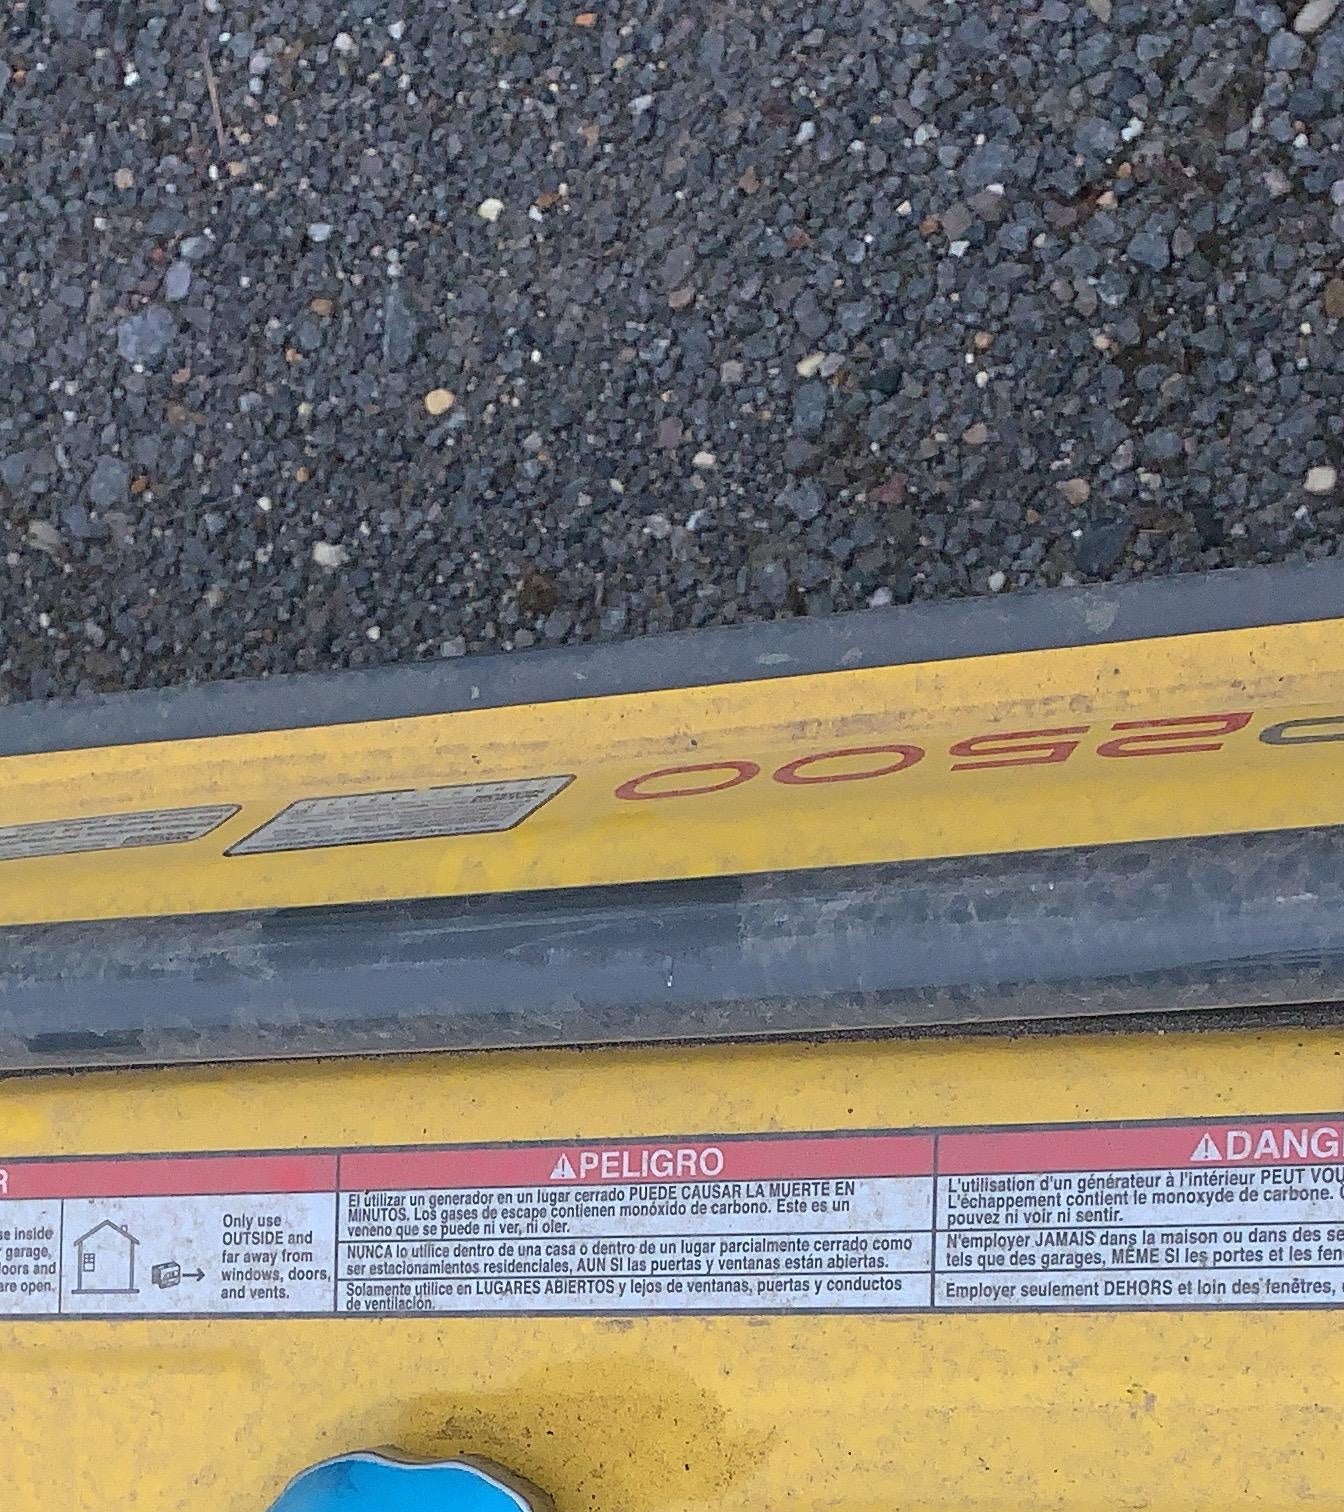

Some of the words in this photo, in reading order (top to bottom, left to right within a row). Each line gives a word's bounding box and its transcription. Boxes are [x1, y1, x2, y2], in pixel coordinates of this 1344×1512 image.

[579, 1147, 724, 1179] PELIGRO
[223, 1214, 253, 1231] Only
[257, 1216, 281, 1227] use
[14, 1226, 54, 1240] inside
[222, 1231, 283, 1245] OUTSIDE
[288, 1231, 313, 1244] and
[947, 1232, 1030, 1252] N'employer
[1035, 1231, 1095, 1246] JAMAIS
[1100, 1230, 1137, 1245] dans
[1142, 1230, 1155, 1244] la
[1160, 1229, 1217, 1244] maison
[1223, 1232, 1243, 1243] ou
[1248, 1228, 1287, 1243] dans
[1292, 1227, 1321, 1242] des
[5, 1247, 52, 1261] garage,
[347, 1245, 392, 1258] NUNCA
[396, 1244, 407, 1258] lo
[412, 1244, 449, 1257] utilice
[454, 1243, 494, 1257] dentro
[499, 1243, 514, 1256] de
[518, 1245, 541, 1256] una
[545, 1245, 575, 1255] casa
[580, 1245, 587, 1255] o
[592, 1241, 635, 1254] dentro
[640, 1240, 656, 1254] de
[660, 1243, 675, 1253] un
[681, 1240, 715, 1258] lugar
[720, 1238, 809, 1257] parcialmente
[814, 1237, 867, 1251] cerrado
[873, 1239, 912, 1250] como
[222, 1250, 239, 1263] far
[243, 1252, 277, 1266] away
[281, 1249, 313, 1262] from
[347, 1264, 365, 1275] ser
[370, 1260, 479, 1274] estacionamientos
[484, 1259, 572, 1276] residenciales,
[577, 1258, 606, 1272] AUN
[610, 1258, 623, 1271] SI
[628, 1258, 646, 1271] las
[651, 1257, 701, 1275] puertas
[706, 1260, 714, 1274] y
[718, 1256, 780, 1270] ventanas
[785, 1255, 823, 1269] están
[827, 1254, 888, 1268] abiertas.
[33, 1261, 56, 1274] and
[221, 1267, 284, 1283] windows,
[288, 1267, 331, 1282] doors,
[221, 1286, 245, 1298] and
[250, 1285, 290, 1298] vents.
[346, 1282, 411, 1296] Solamente
[415, 1282, 453, 1295] utilice
[457, 1285, 472, 1295] en
[476, 1281, 540, 1294] LUGARES
[544, 1280, 614, 1294] ABIERTOS
[619, 1283, 626, 1297] y
[630, 1279, 662, 1297] lejos
[667, 1279, 682, 1292] de
[687, 1278, 753, 1295] ventanas,
[758, 1278, 810, 1296] puertas
[814, 1280, 822, 1295] y
[827, 1276, 902, 1290] conductos
[946, 1282, 1015, 1301] Employer
[1020, 1281, 1099, 1296] seulement
[1105, 1280, 1173, 1295] DEHORS
[1178, 1280, 1192, 1294] et
[1197, 1280, 1226, 1294] loin
[1232, 1280, 1260, 1294] des
[1266, 1279, 1336, 1296] fenêtres,
[346, 1297, 361, 1310] de
[365, 1296, 435, 1309] ventilación.
